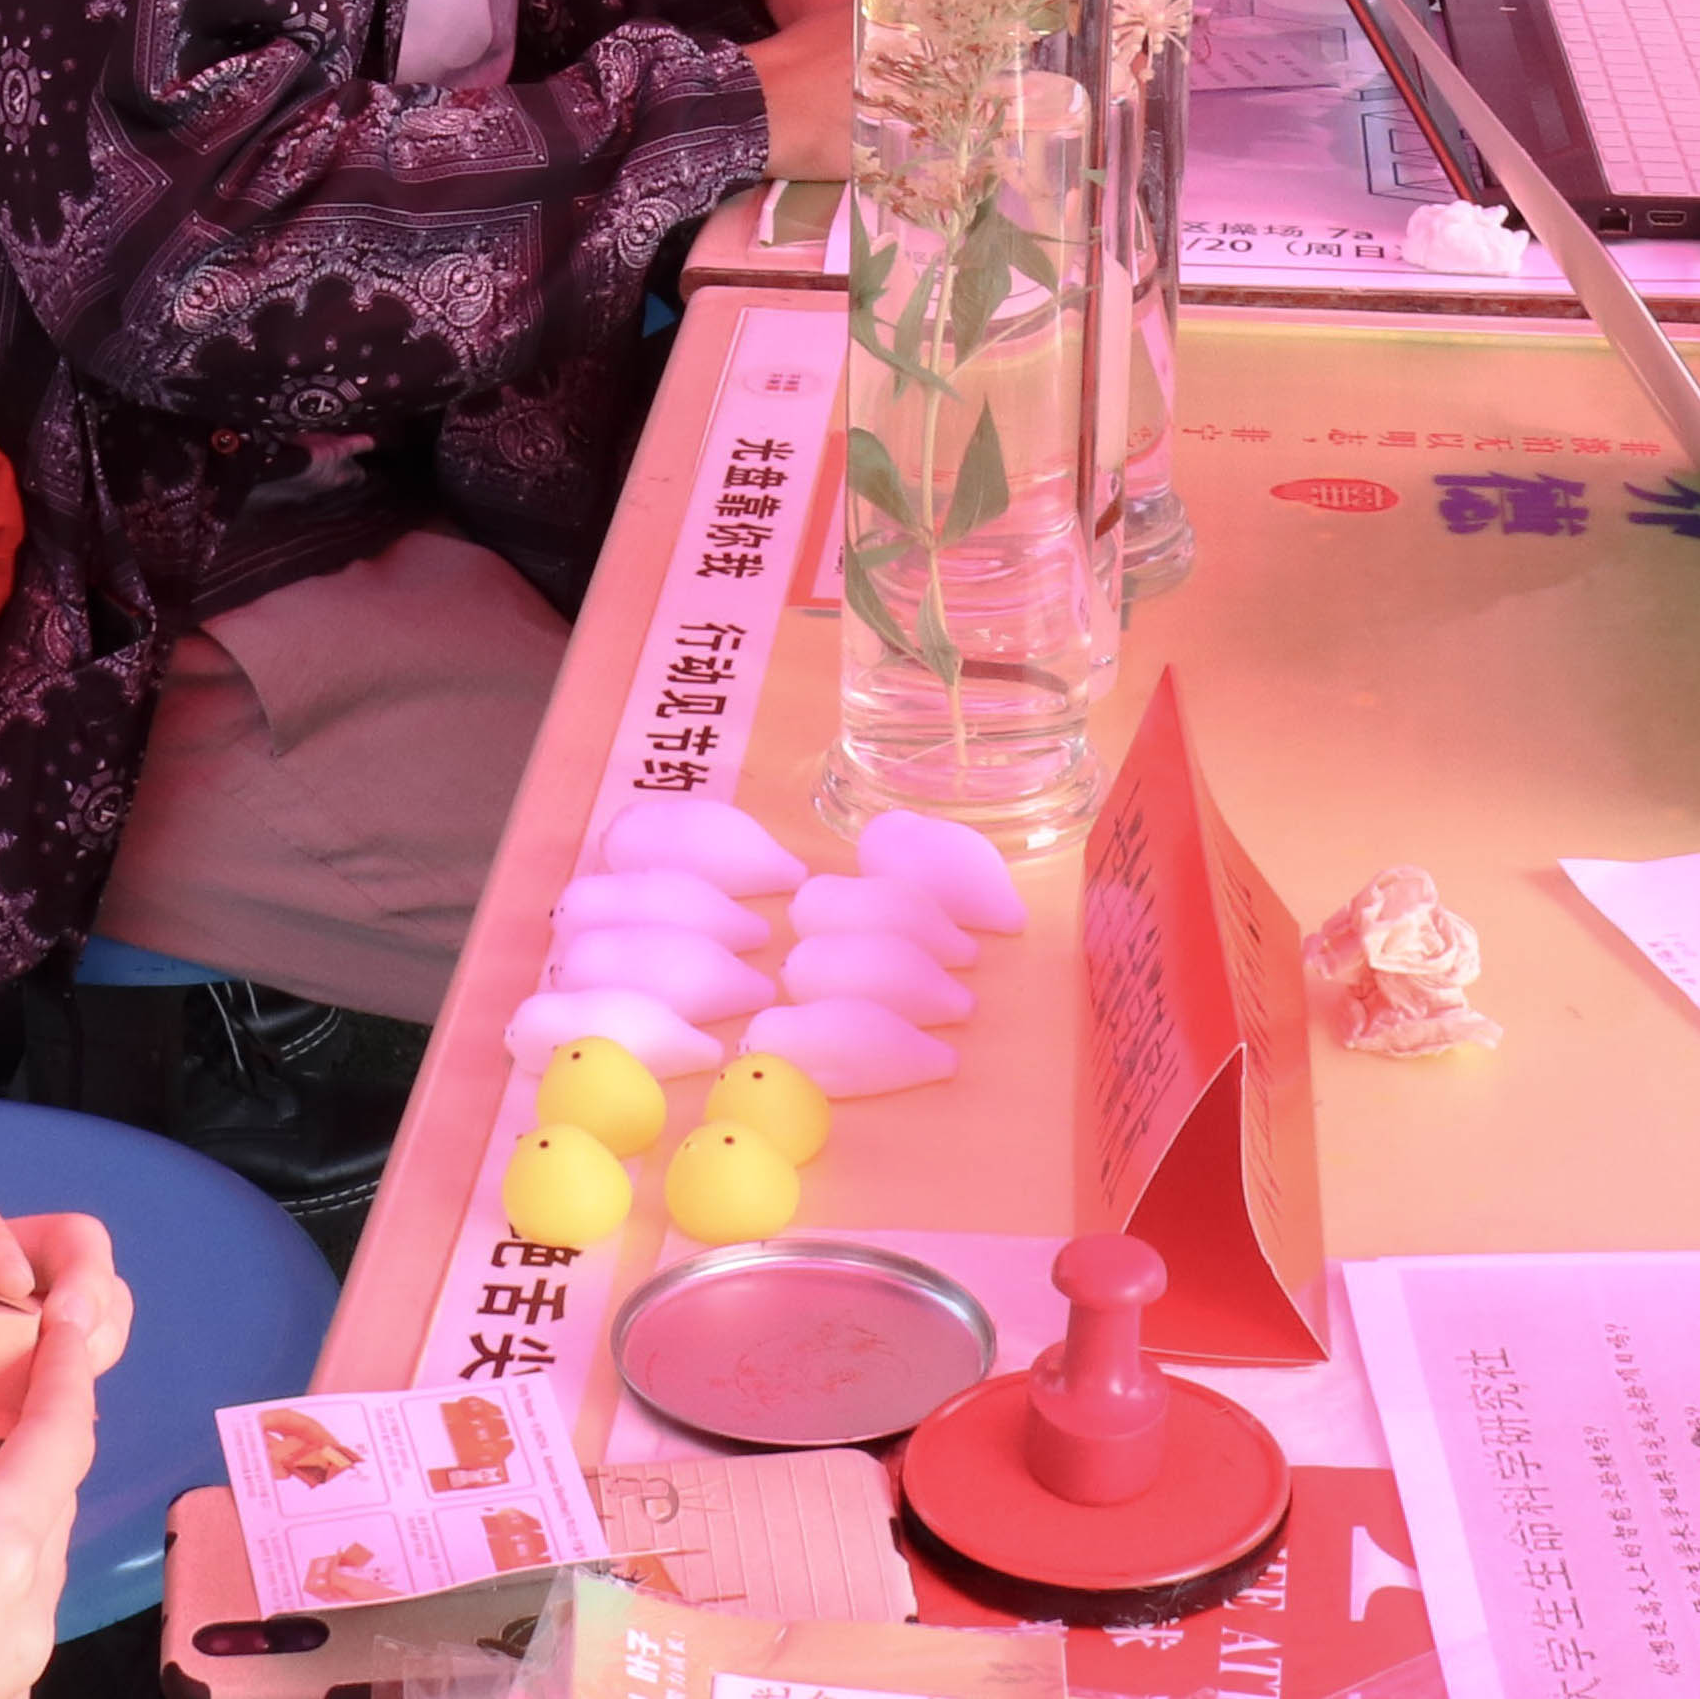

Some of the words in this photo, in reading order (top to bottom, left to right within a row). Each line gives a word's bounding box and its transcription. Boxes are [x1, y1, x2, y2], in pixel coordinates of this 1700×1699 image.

[695, 436, 795, 580] 光盘靠你我
[632, 622, 748, 793] 行动见节约
